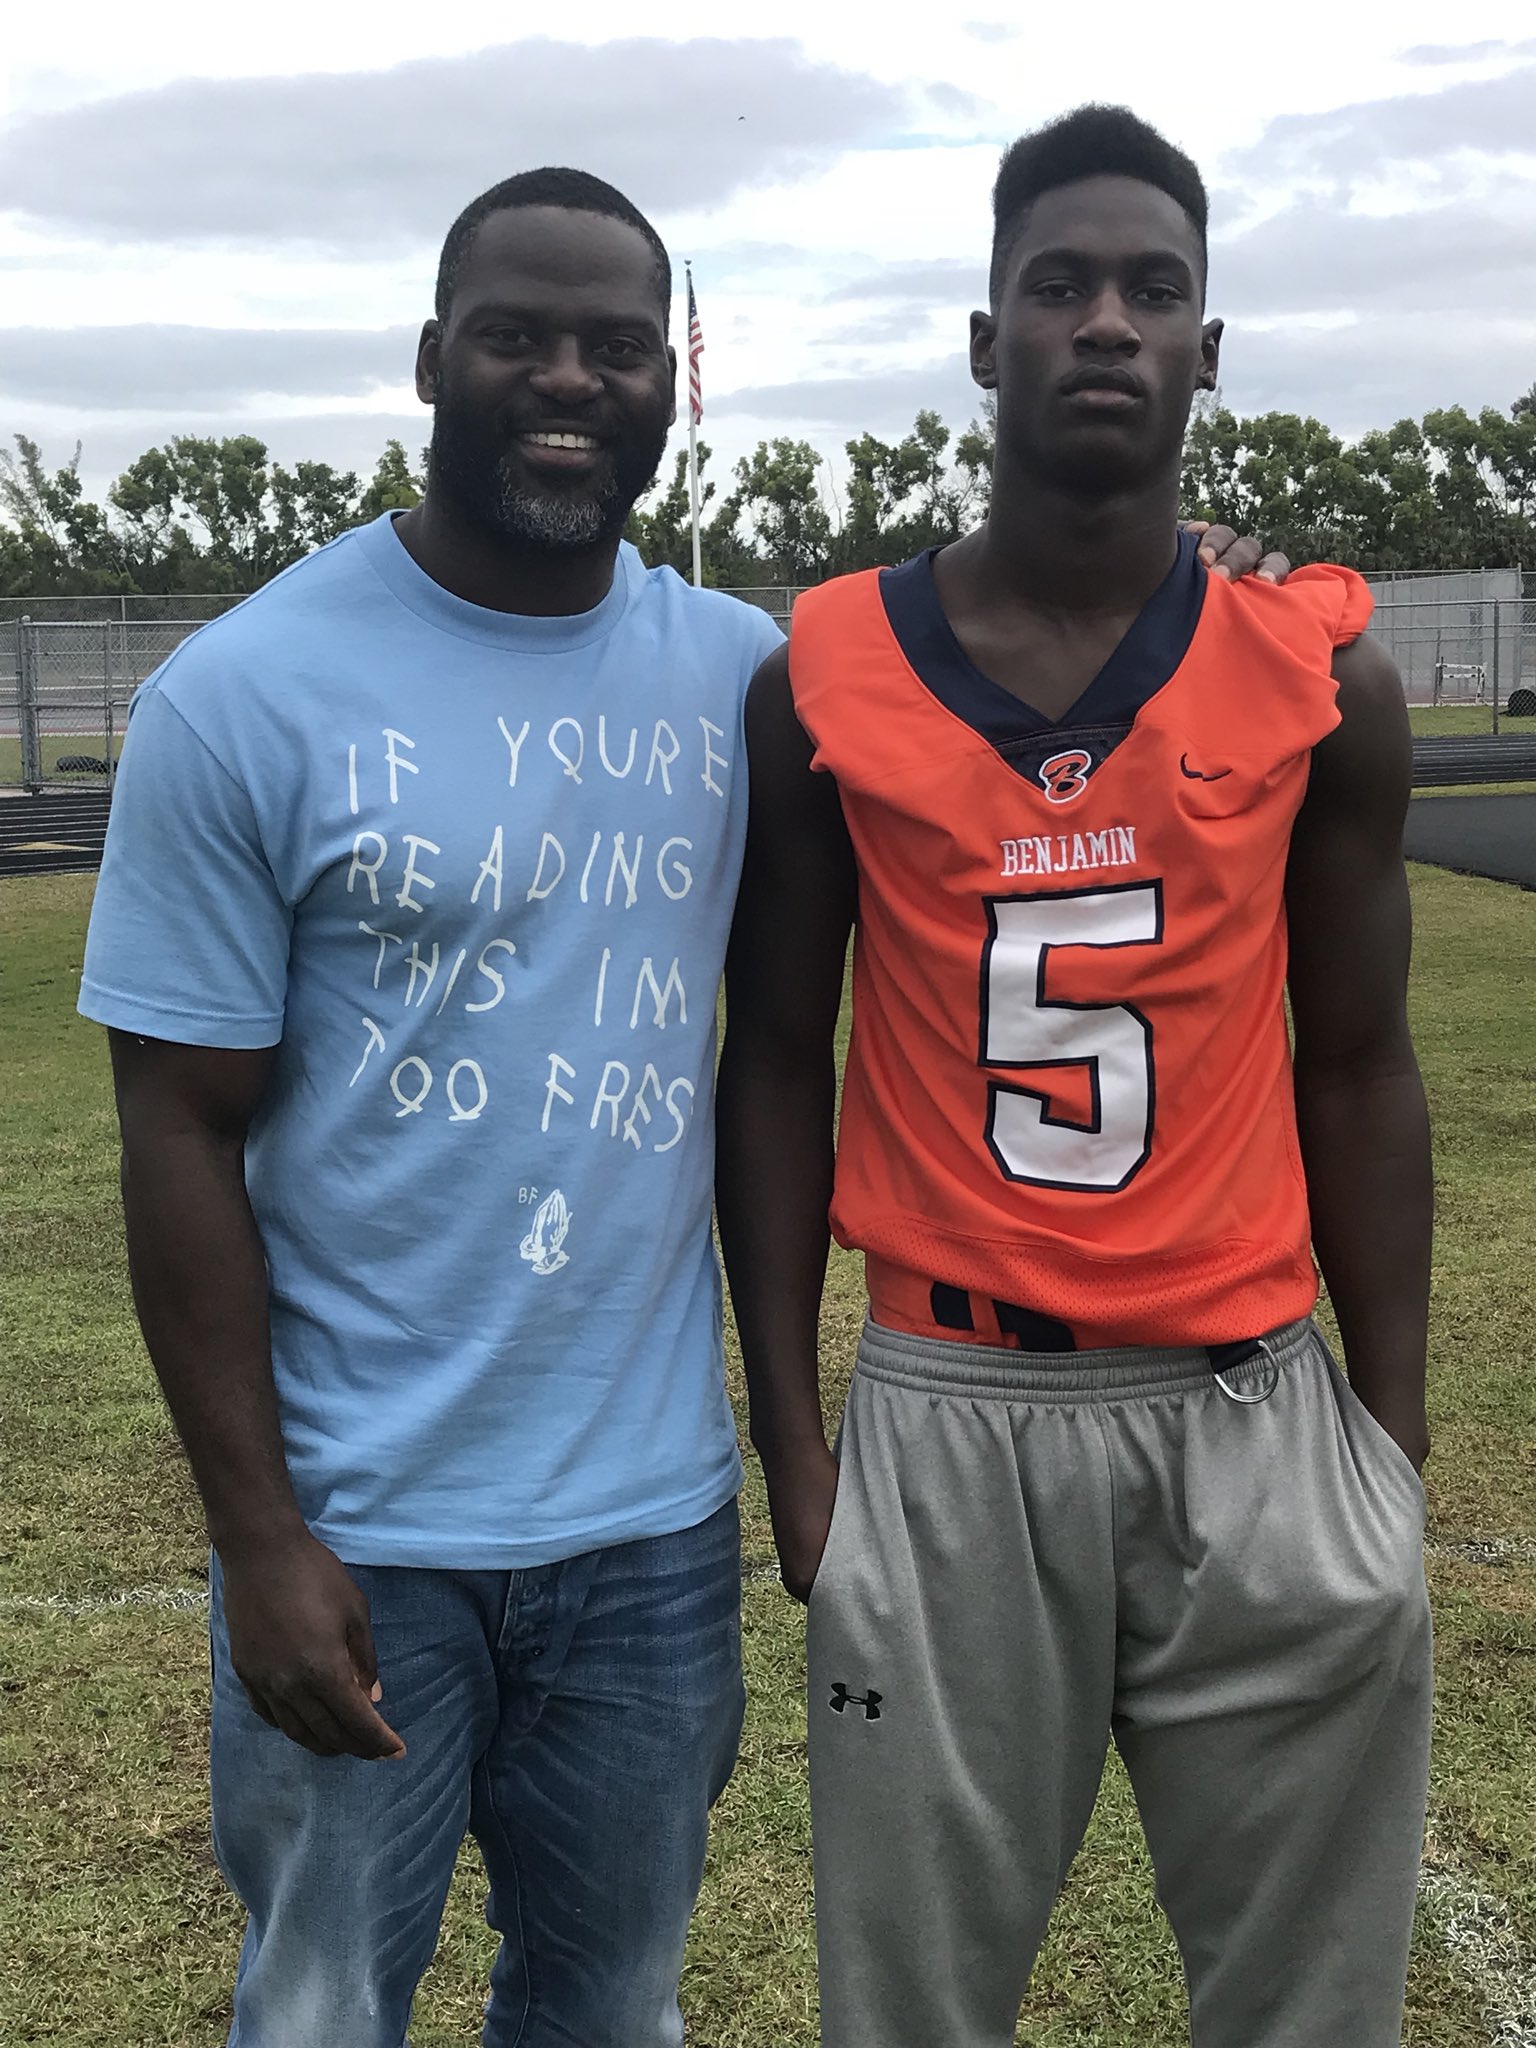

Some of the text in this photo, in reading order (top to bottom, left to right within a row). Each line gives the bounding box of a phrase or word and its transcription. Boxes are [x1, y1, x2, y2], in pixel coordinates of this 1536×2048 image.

[348, 728, 419, 814] IF
[346, 825, 693, 912] READING
[1000, 826, 1137, 876] BENJAMIN
[358, 920, 687, 1029] THIS IM
[348, 1017, 695, 1152] TOO FRES
[978, 877, 1163, 1194] 5
